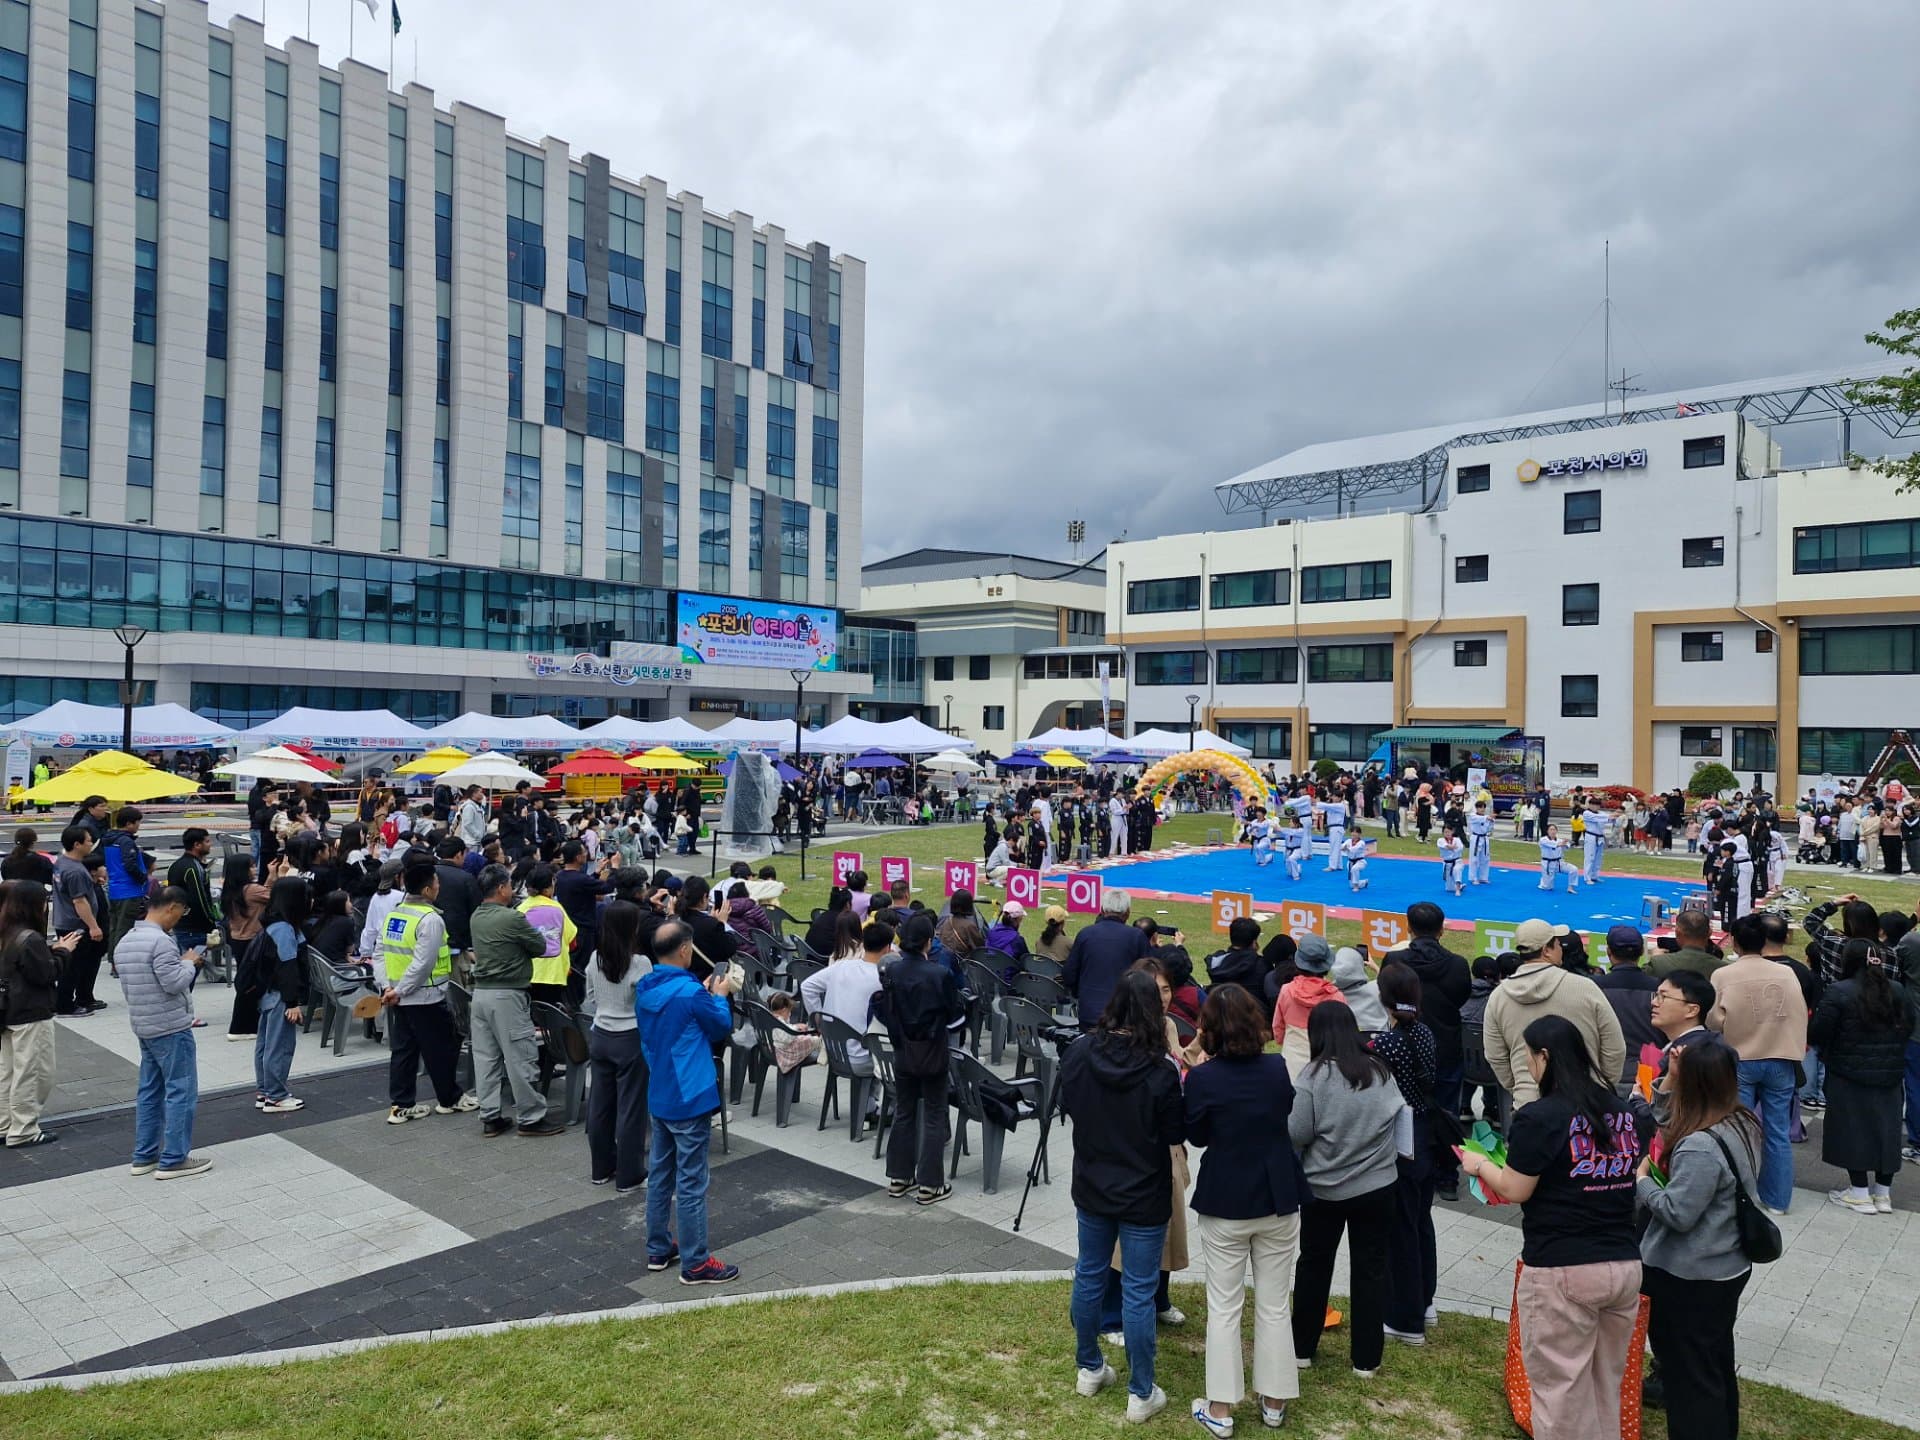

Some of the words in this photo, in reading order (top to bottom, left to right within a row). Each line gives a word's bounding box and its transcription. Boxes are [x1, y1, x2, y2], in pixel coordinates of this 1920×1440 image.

[1547, 448, 1648, 477] 포천시의회
[706, 612, 753, 635] 포천시
[753, 615, 812, 641] 어린이날
[570, 662, 600, 675] 소통과
[602, 664, 630, 677] 신뢰의
[631, 665, 672, 679] 시민중심
[673, 668, 692, 680] 포천
[950, 866, 972, 891] 한
[1011, 874, 1037, 902] 아
[1071, 880, 1097, 908] 이
[1288, 908, 1318, 940] 망
[1369, 917, 1402, 952] 찬
